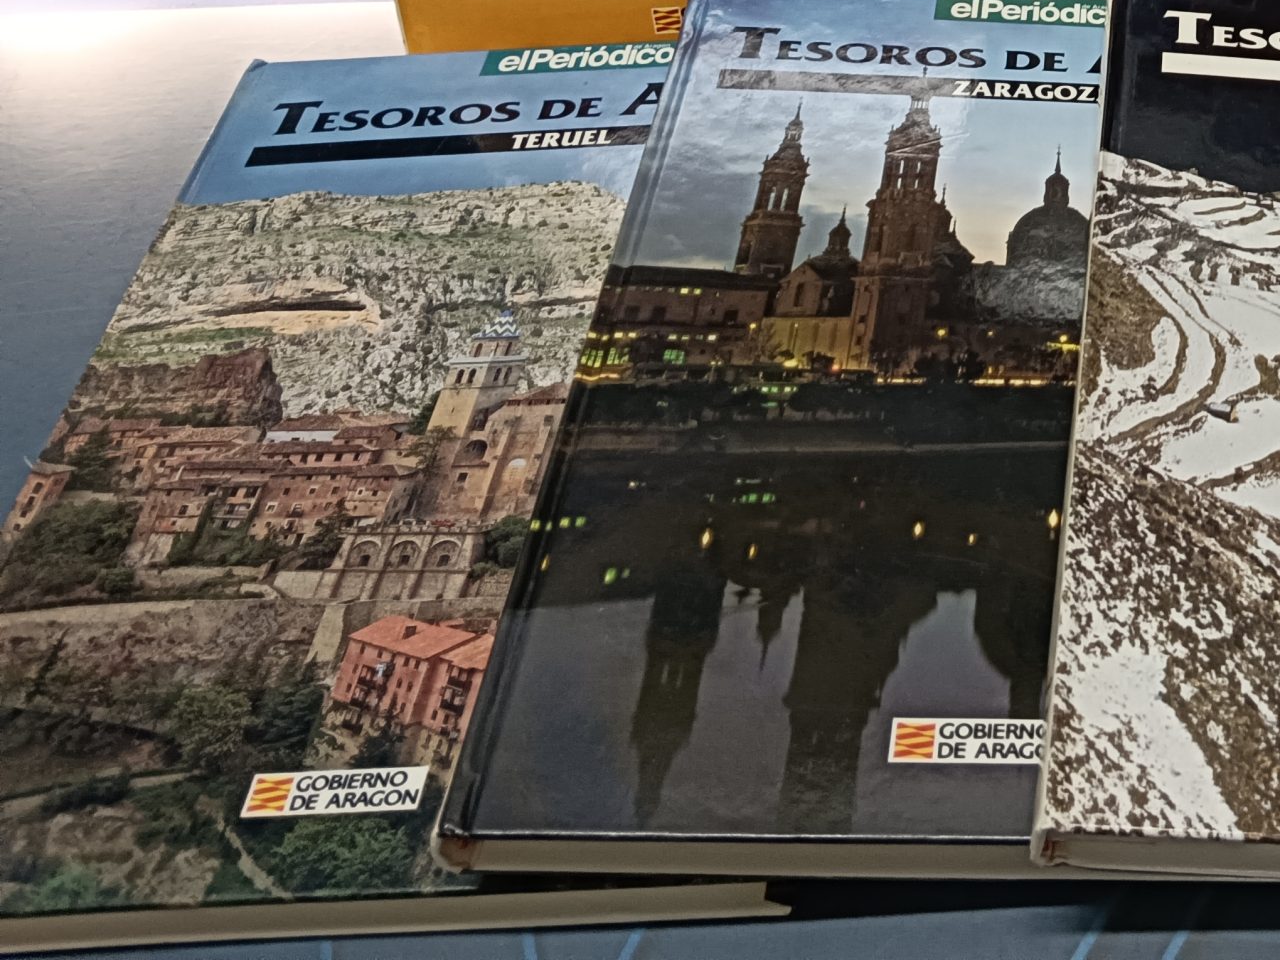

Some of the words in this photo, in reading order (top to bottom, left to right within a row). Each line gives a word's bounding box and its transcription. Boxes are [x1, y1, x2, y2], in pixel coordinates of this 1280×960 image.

[733, 26, 987, 70] TESOROS
[1004, 50, 1068, 73] DE
[952, 80, 1101, 102] ZARAGOZ
[272, 100, 521, 136] TESOROS
[536, 96, 603, 121] DE
[512, 129, 612, 150] TERUEL
[937, 742, 966, 759] DE
[296, 770, 409, 791] GOBIERNO
[289, 793, 320, 812] DE
[325, 789, 420, 810] ARAGON
